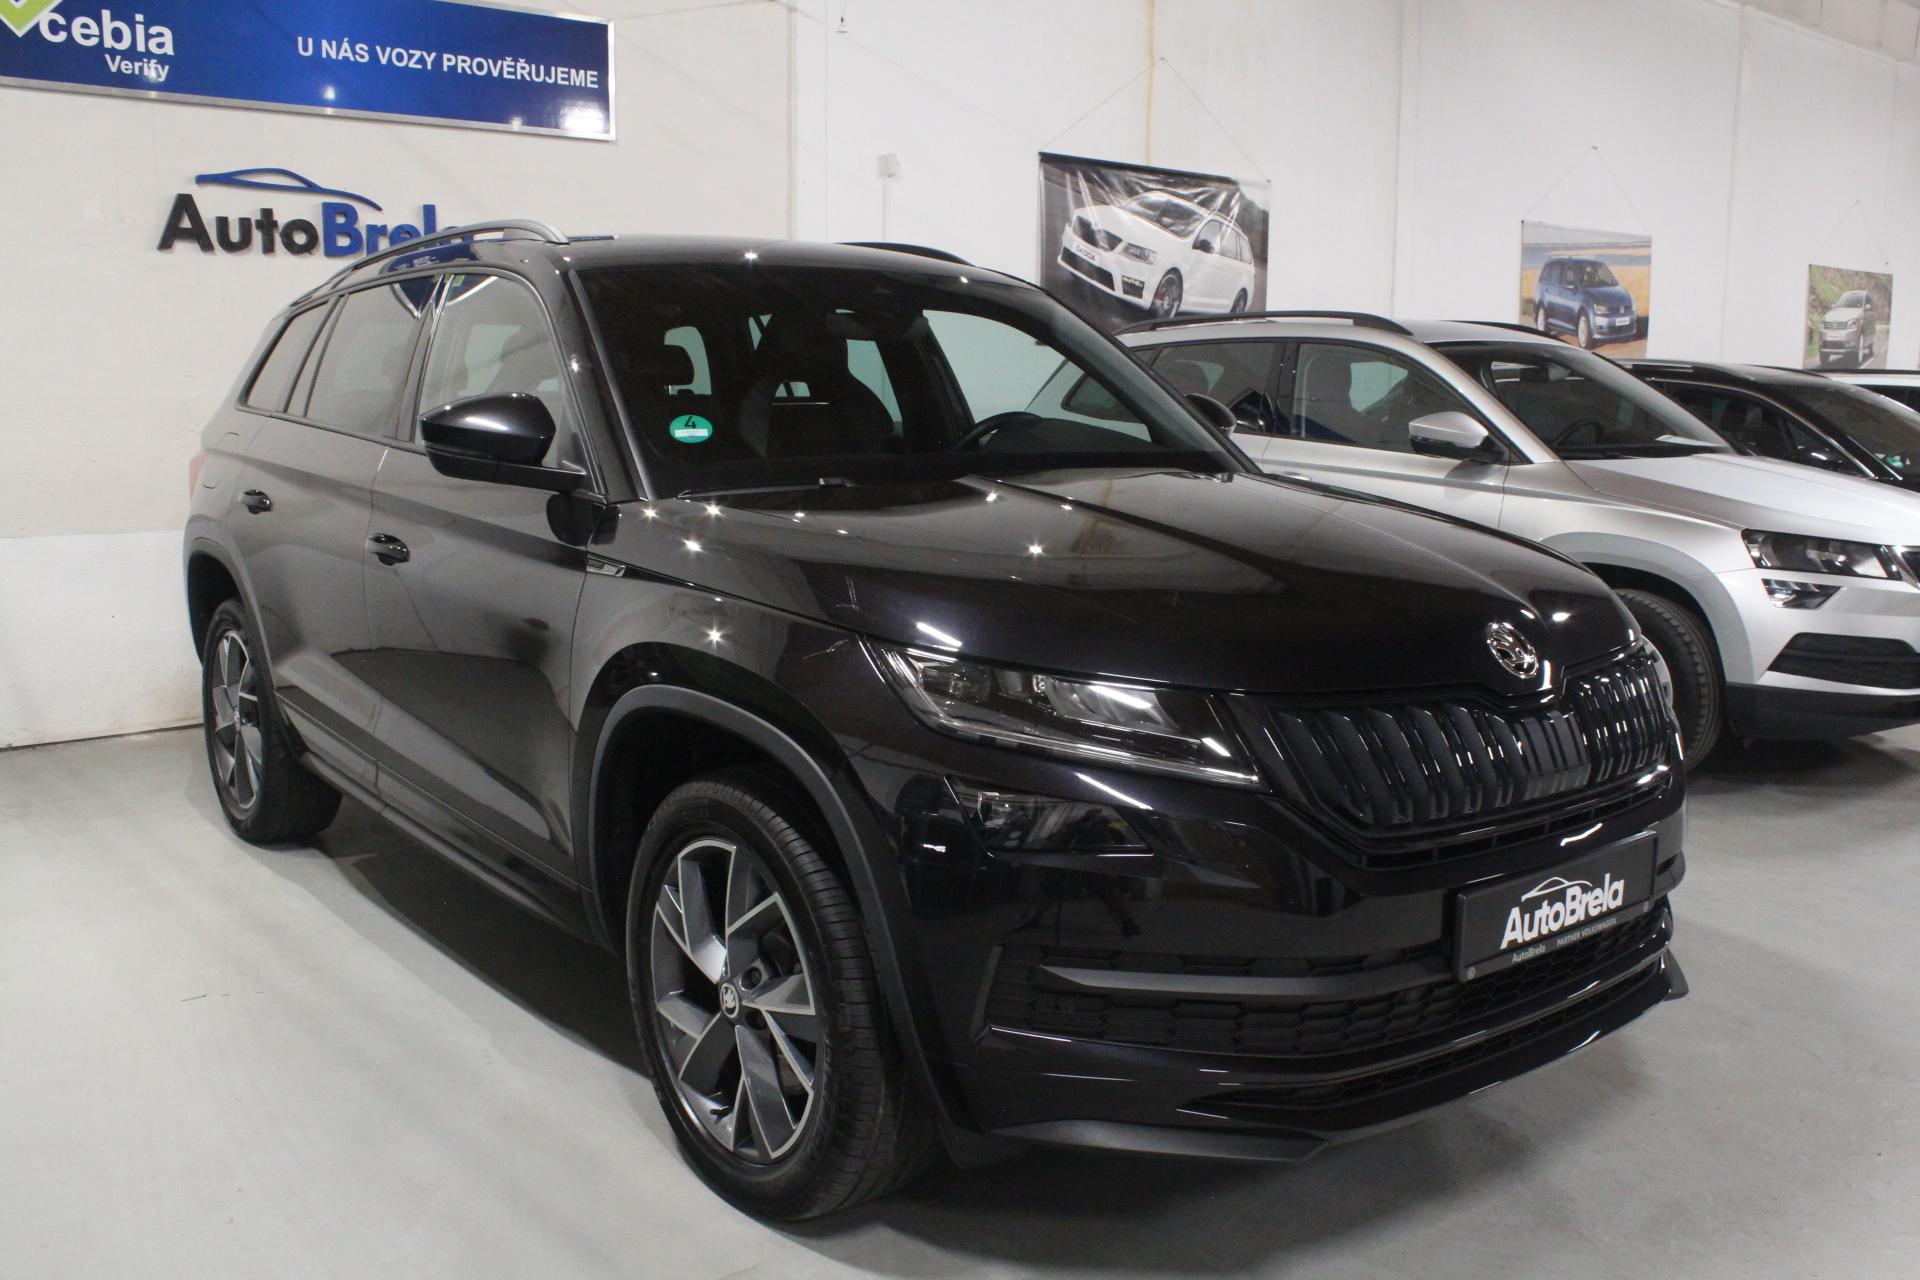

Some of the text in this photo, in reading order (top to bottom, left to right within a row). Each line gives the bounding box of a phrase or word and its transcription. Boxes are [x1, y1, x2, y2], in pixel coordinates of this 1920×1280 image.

[39, 9, 174, 56] cebia
[104, 54, 170, 82] Verify
[297, 36, 599, 89] U NÁS VOZY PROVĚŘUJEME
[157, 193, 474, 258] AutoBrel
[684, 415, 697, 430] 4
[1500, 872, 1625, 950] AutoBrela
[1512, 943, 1546, 964] AutoBrela
